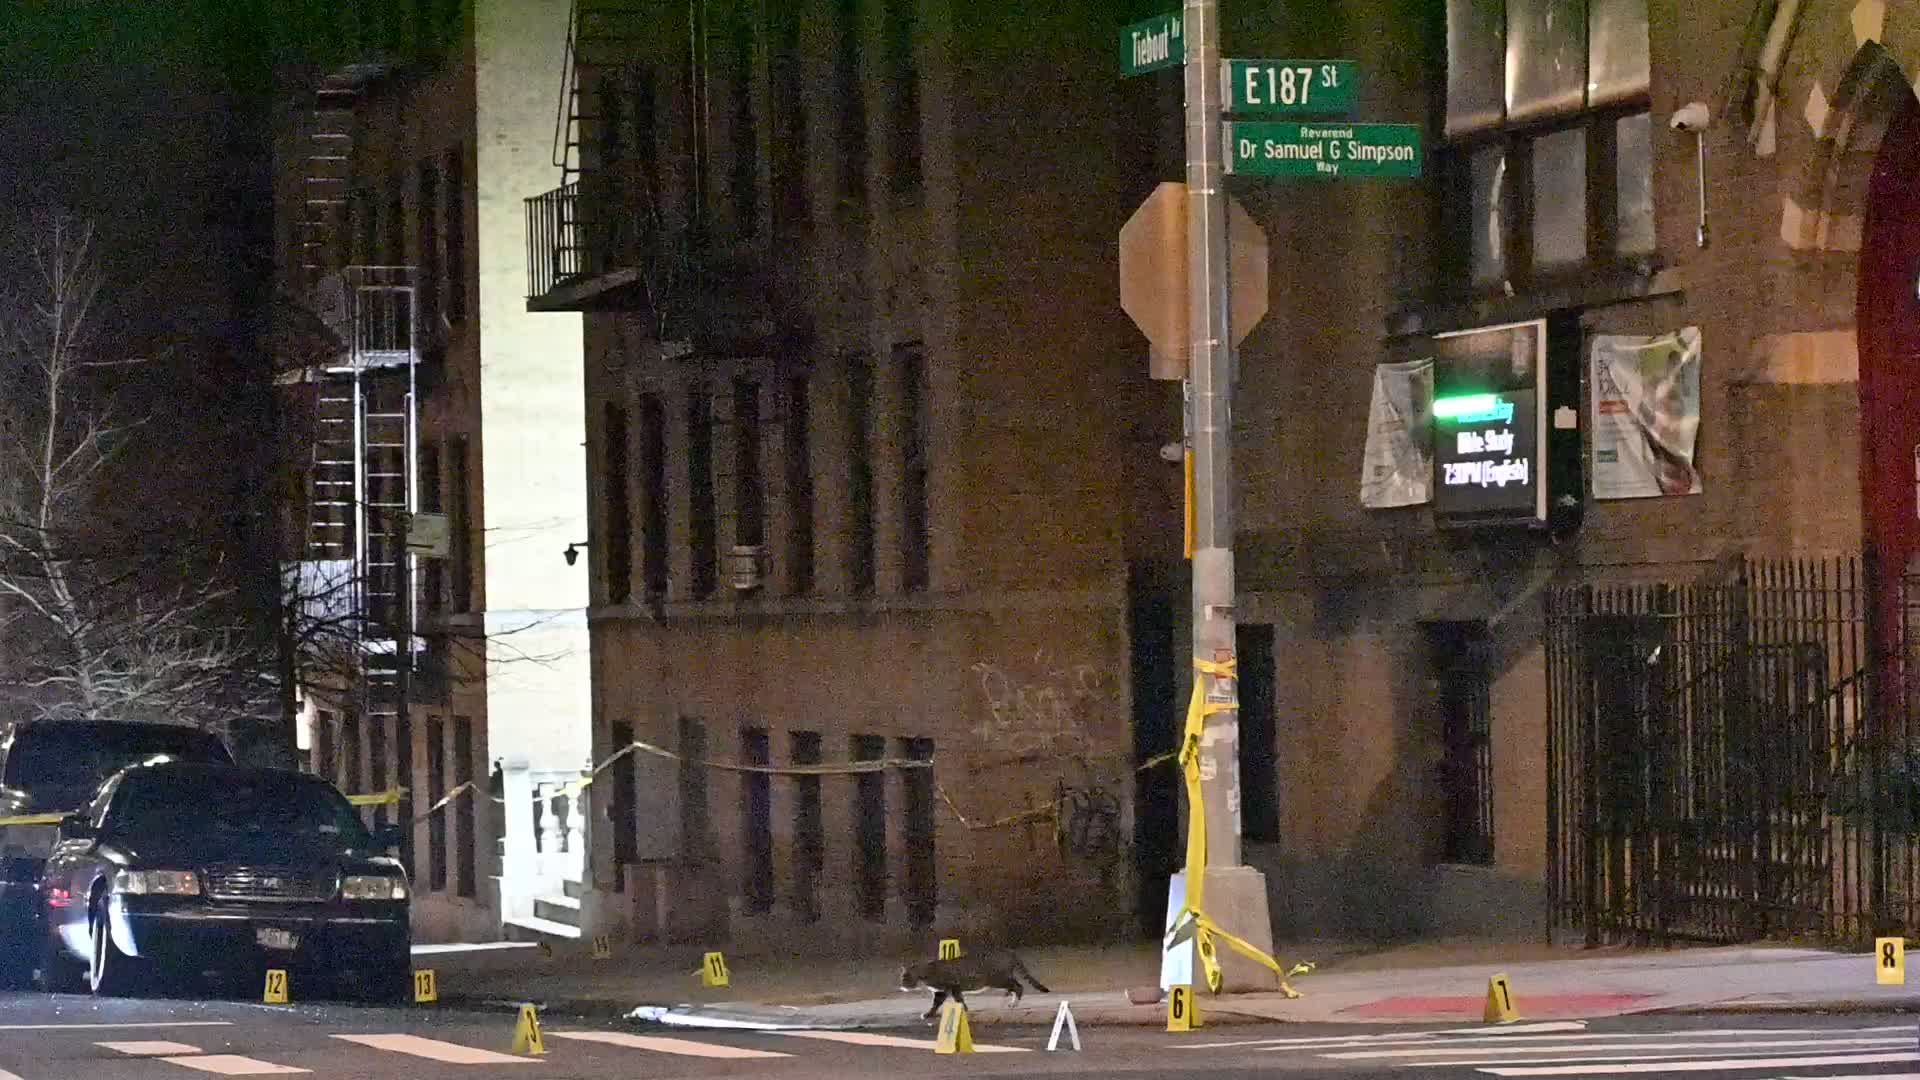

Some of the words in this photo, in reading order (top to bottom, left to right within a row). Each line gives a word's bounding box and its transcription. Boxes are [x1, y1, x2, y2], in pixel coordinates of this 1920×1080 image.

[1132, 23, 1168, 68] Tiebout
[1245, 67, 1261, 105] E
[1265, 66, 1313, 105] 187
[1321, 64, 1337, 87] St
[1300, 127, 1353, 139] Reverend
[1239, 139, 1257, 159] Dr
[1264, 139, 1323, 159] Samuel
[1329, 141, 1341, 160] G
[1347, 140, 1414, 165] Simpson
[1315, 161, 1339, 176] Way
[1484, 428, 1515, 455] Study
[943, 943, 956, 960] 10
[1882, 942, 1896, 968] 8
[709, 955, 724, 977] 11
[268, 973, 282, 994] 12
[416, 974, 431, 995] 13
[1497, 980, 1511, 1011] 7
[1173, 987, 1184, 1019] 6
